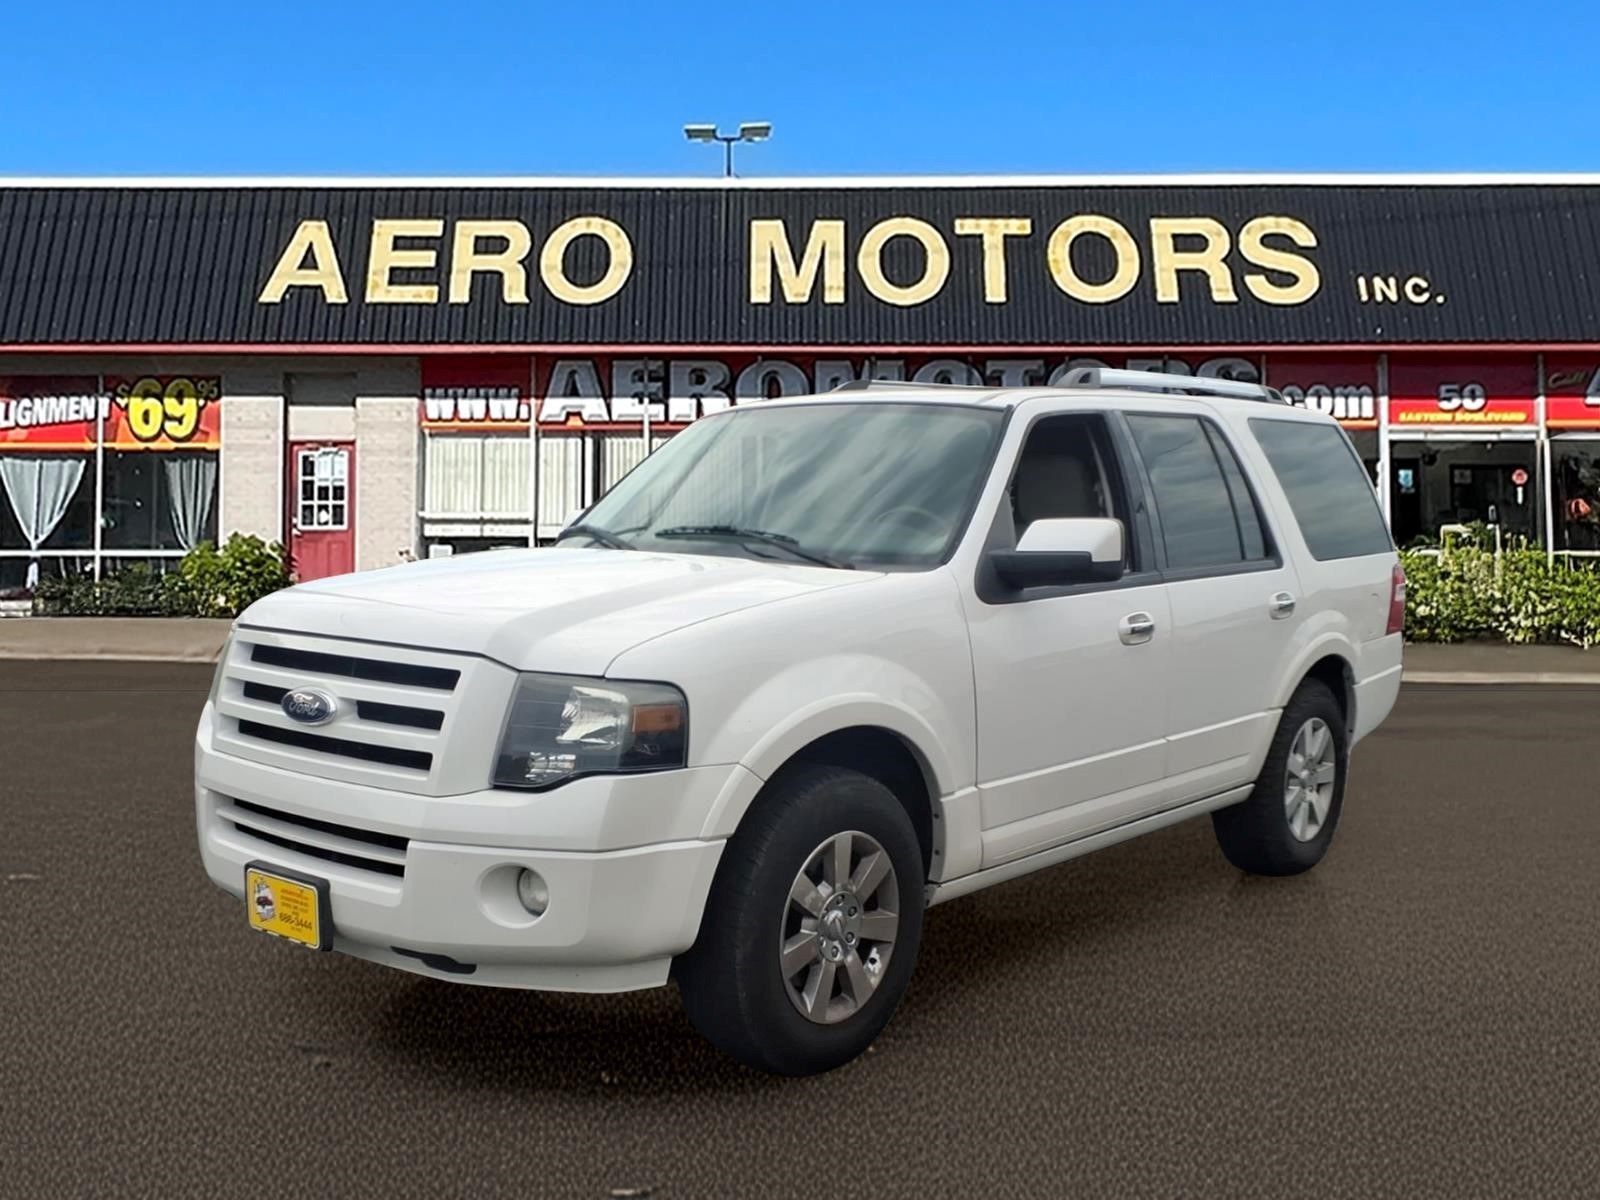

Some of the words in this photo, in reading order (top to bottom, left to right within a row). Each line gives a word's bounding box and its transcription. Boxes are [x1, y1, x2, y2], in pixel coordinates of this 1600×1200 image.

[257, 216, 634, 306] AERO
[749, 215, 1321, 307] MOTORS
[1356, 275, 1446, 305] INC.
[1437, 383, 1487, 412] 50
[1399, 411, 1453, 423] EASTERN
[1454, 411, 1527, 423] BOULEVARD
